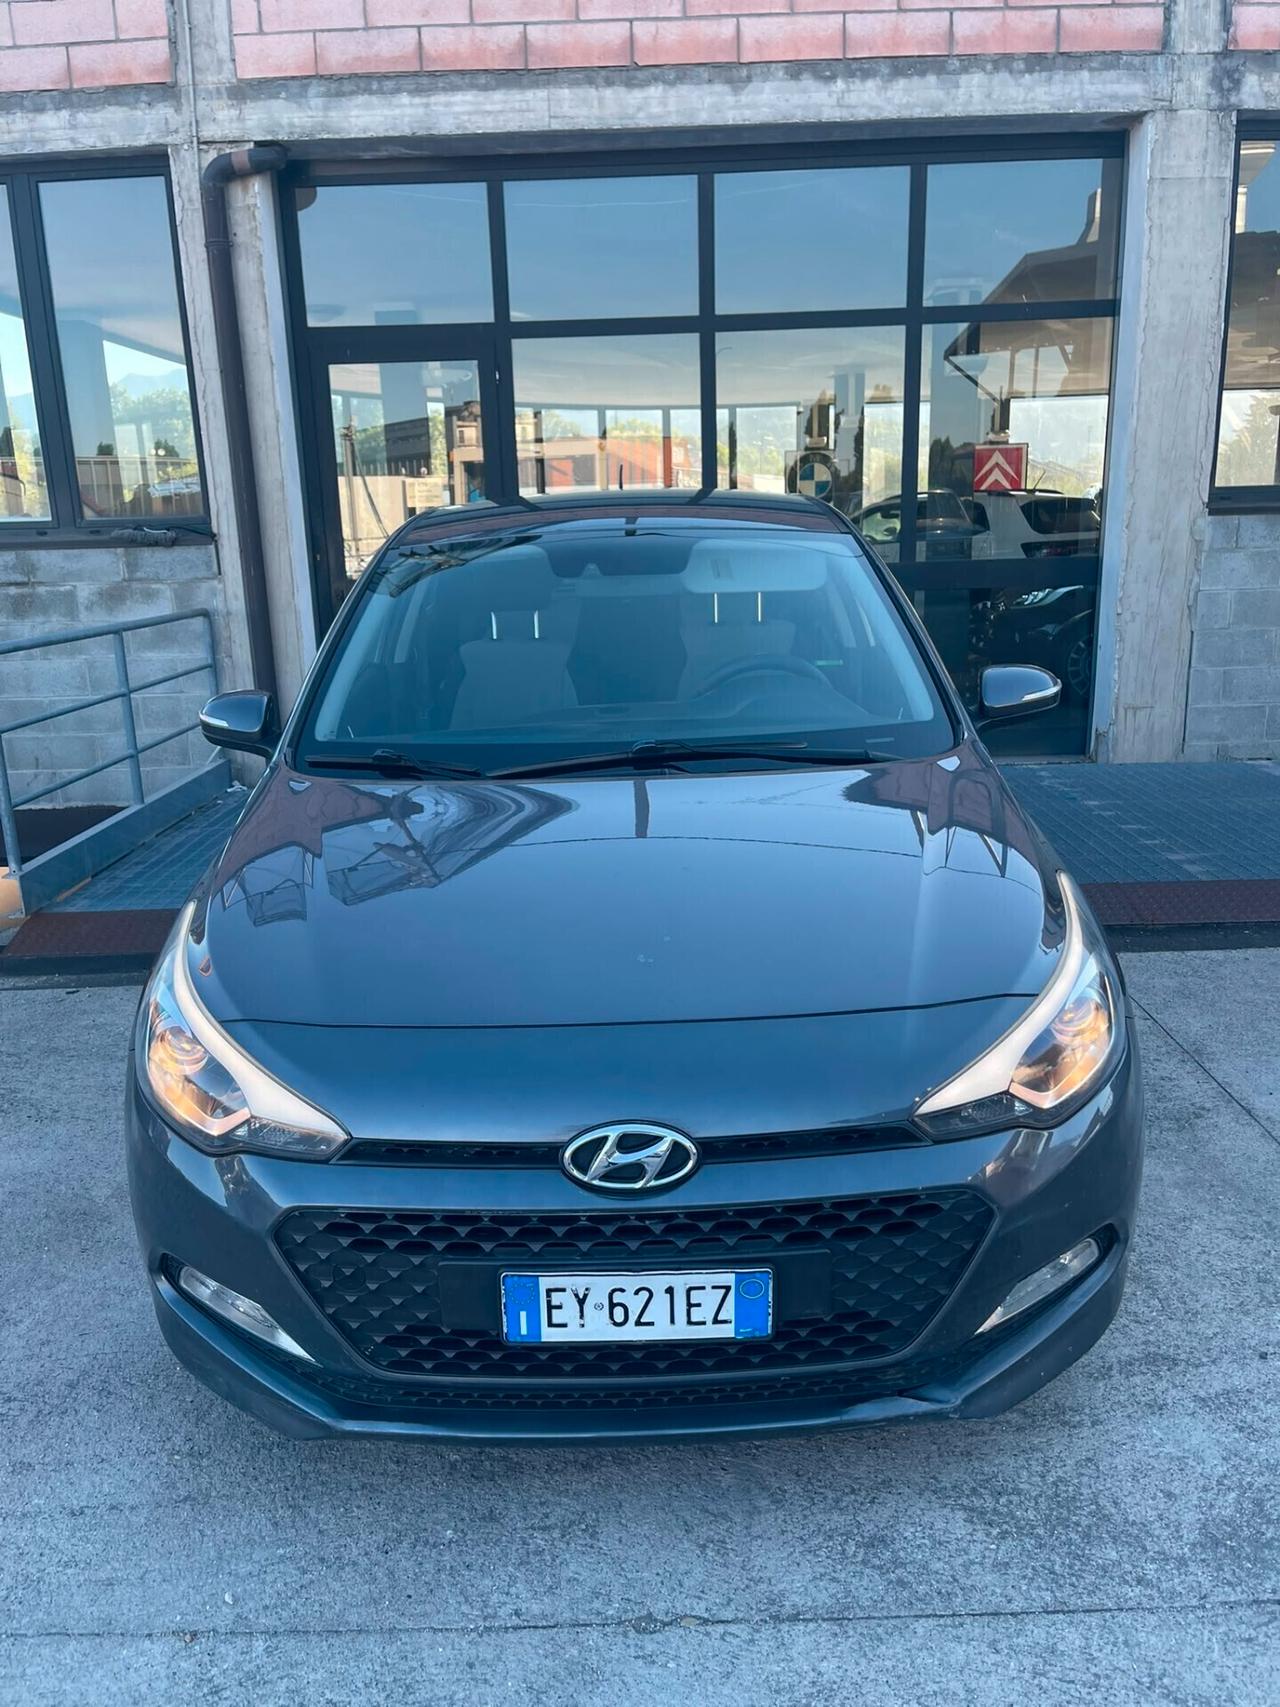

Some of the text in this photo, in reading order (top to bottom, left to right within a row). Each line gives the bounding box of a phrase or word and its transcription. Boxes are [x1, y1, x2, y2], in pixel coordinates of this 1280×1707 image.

[520, 1285, 732, 1335] I EY 621EZ
